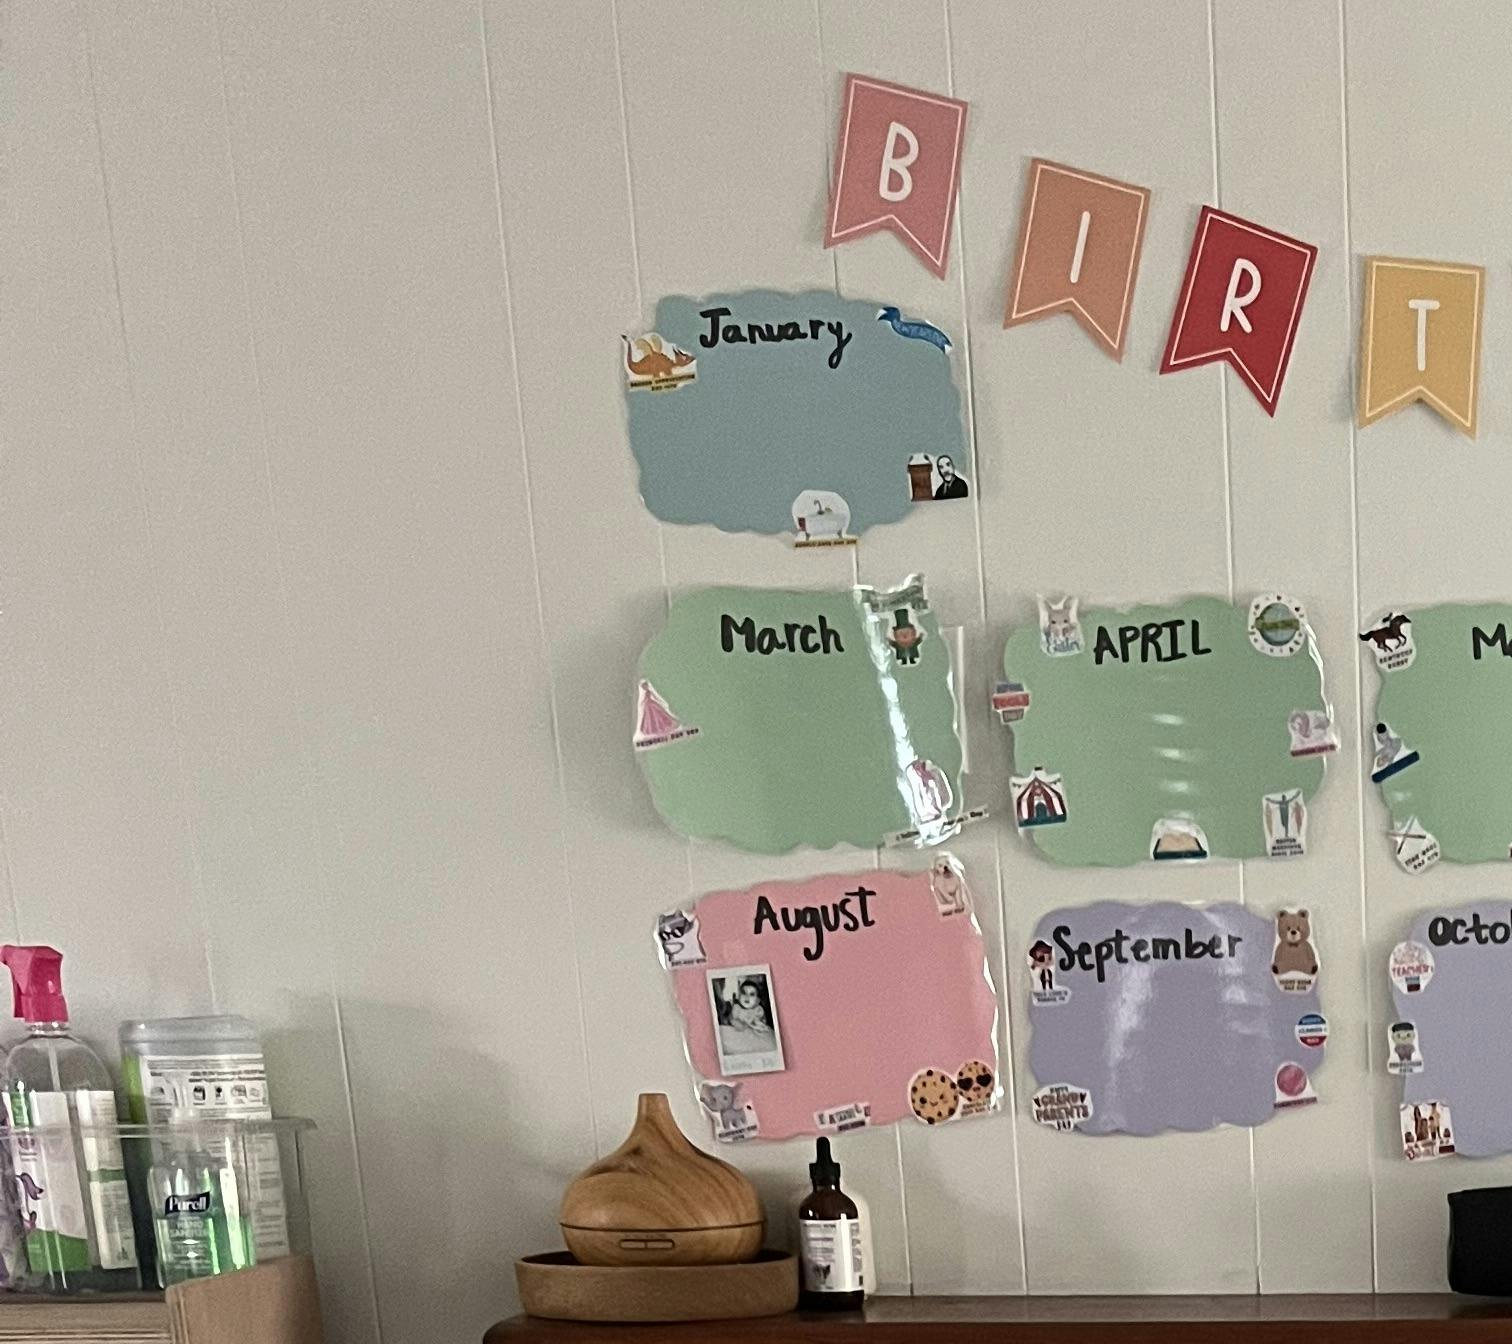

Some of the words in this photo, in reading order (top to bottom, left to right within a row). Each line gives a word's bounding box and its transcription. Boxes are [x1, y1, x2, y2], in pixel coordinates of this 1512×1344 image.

[700, 307, 852, 369] January
[720, 614, 844, 655] March
[1093, 619, 1212, 665] APRIL
[754, 886, 877, 961] August
[1052, 925, 1242, 982] September
